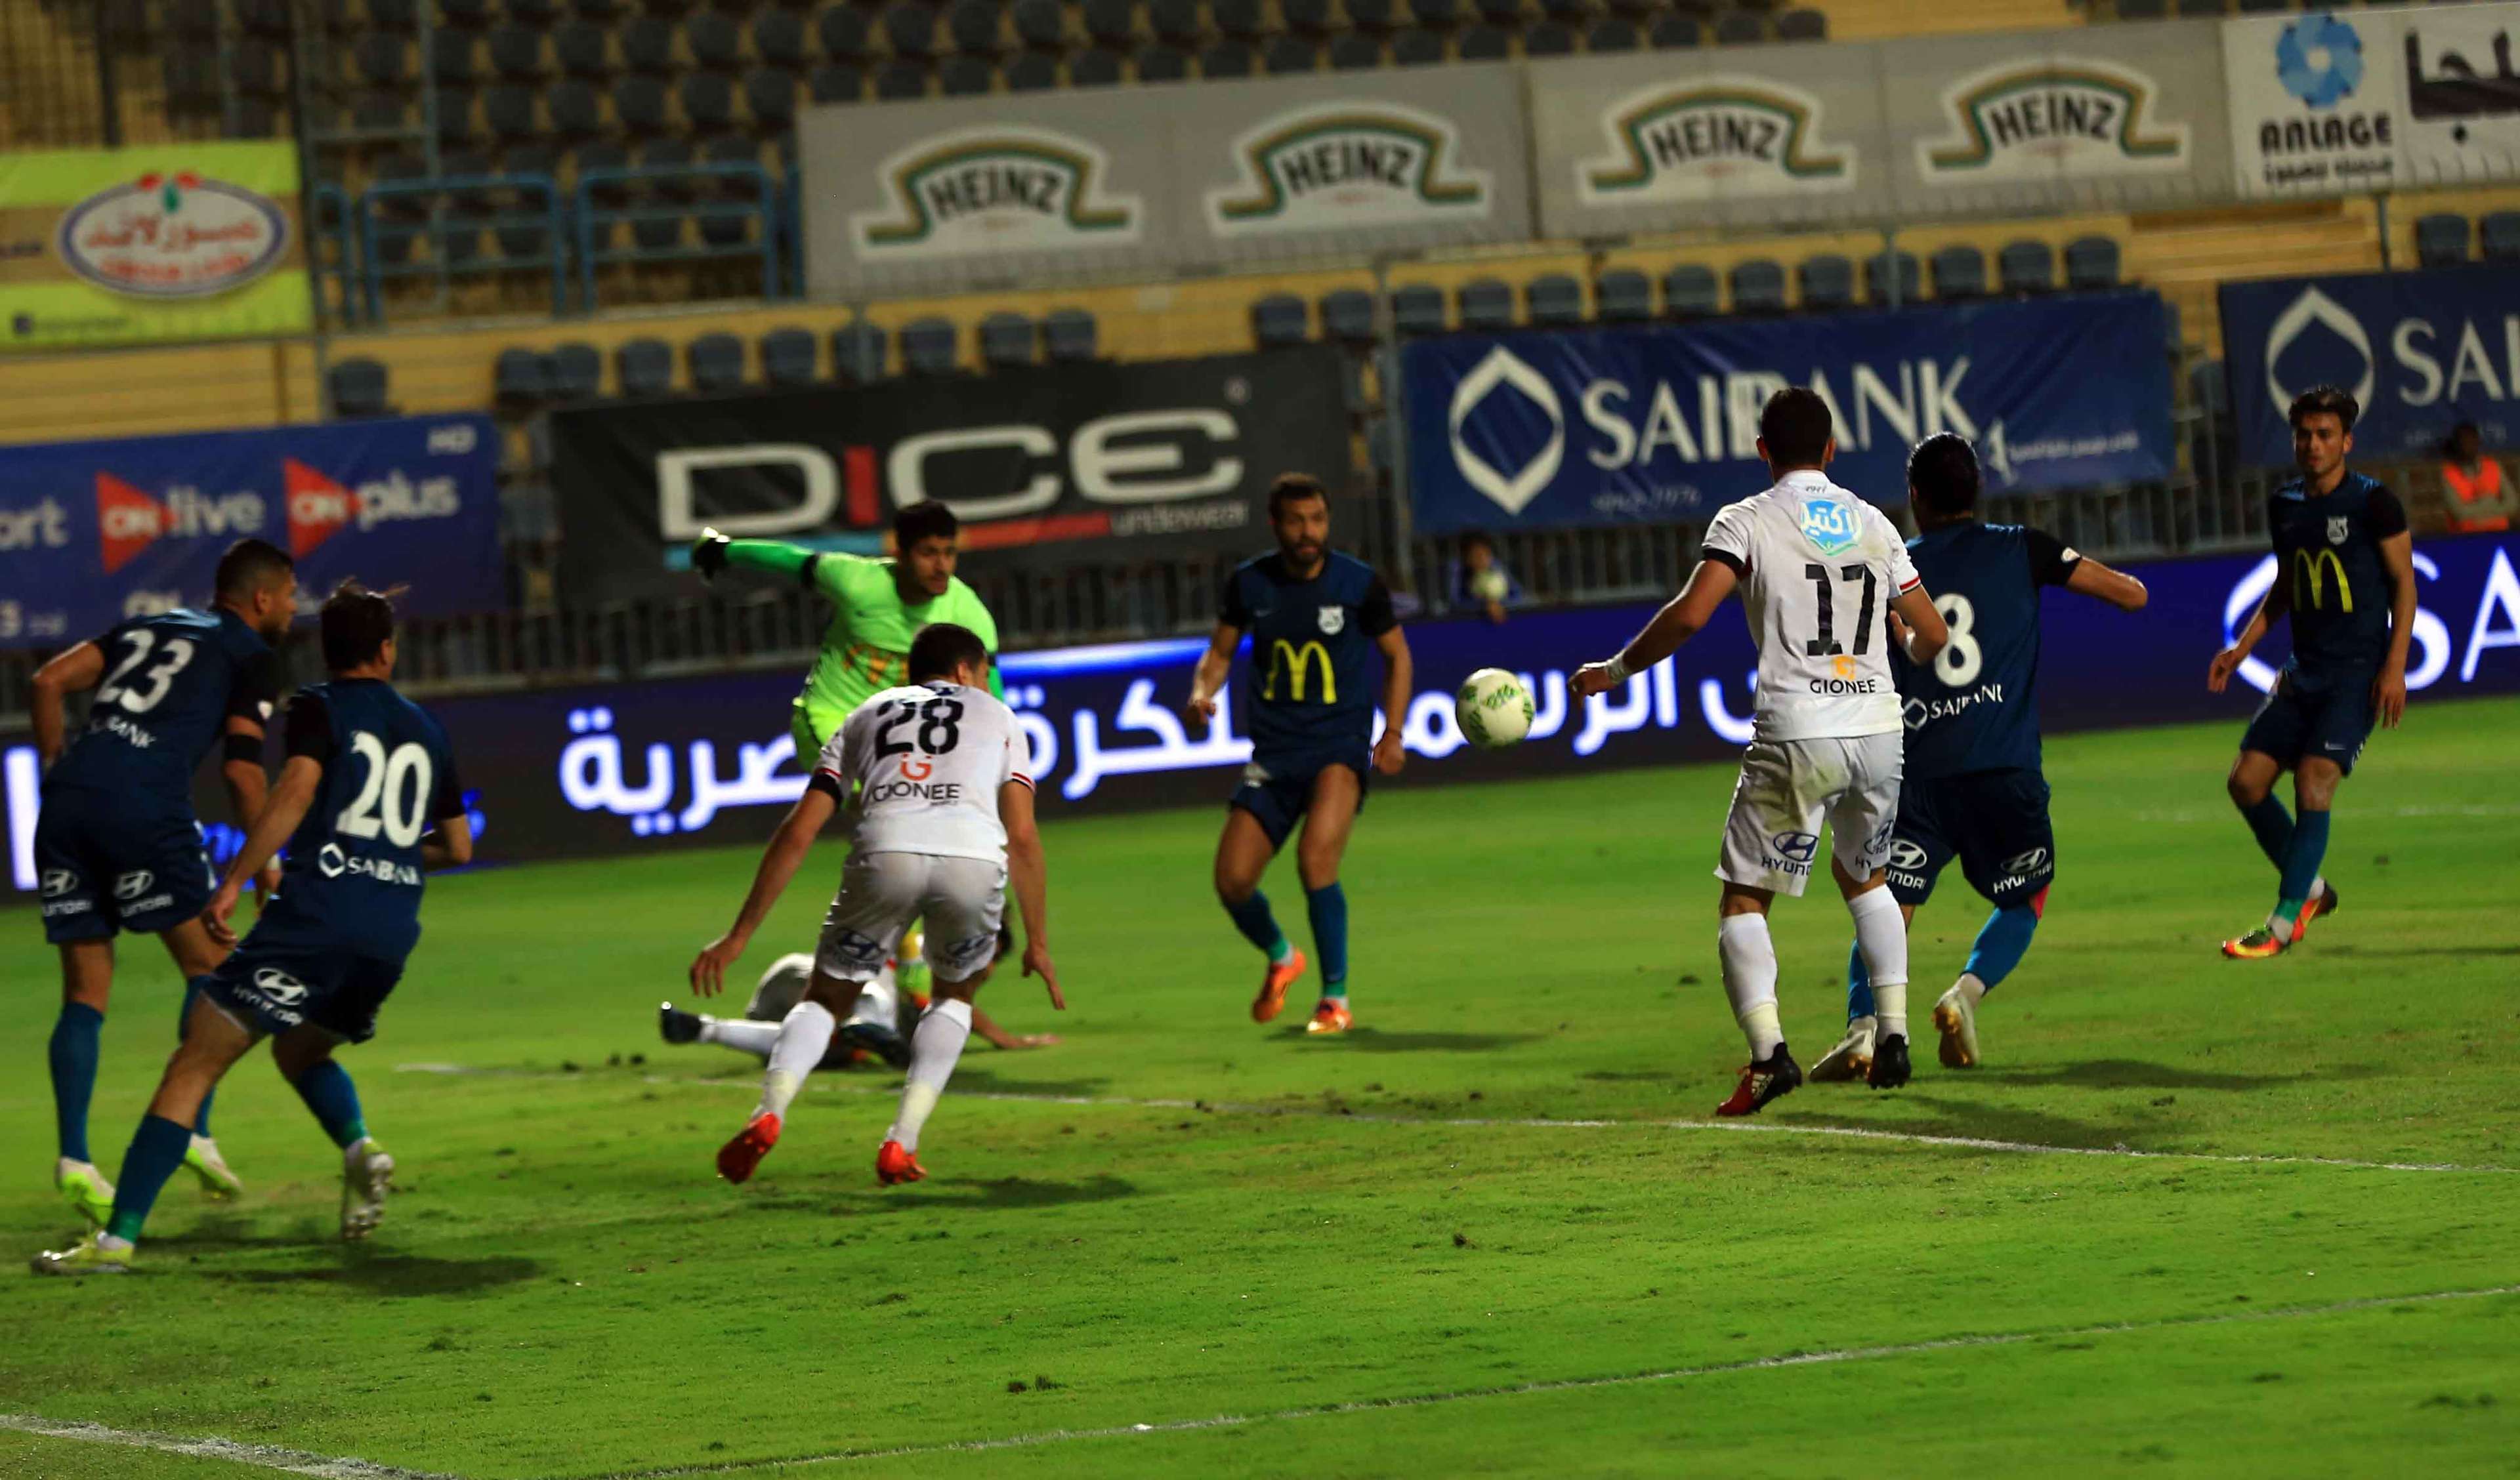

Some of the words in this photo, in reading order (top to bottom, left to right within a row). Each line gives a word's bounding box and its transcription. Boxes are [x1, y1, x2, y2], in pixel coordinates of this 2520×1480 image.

[1650, 113, 1781, 168] HEINZ
[1990, 94, 2116, 147] HEINZ
[2259, 111, 2393, 156] ANLAGE
[927, 160, 1060, 219] HEINZ
[1280, 137, 1413, 195] HEINZ
[166, 484, 265, 537] live
[357, 467, 461, 533] plus
[658, 408, 1244, 541] DICE
[1805, 564, 1877, 657] 17
[1934, 592, 1983, 688] 8
[93, 628, 195, 714] 23
[1809, 678, 1876, 694] GIONEE
[874, 697, 964, 760] 28
[335, 730, 433, 848] 20
